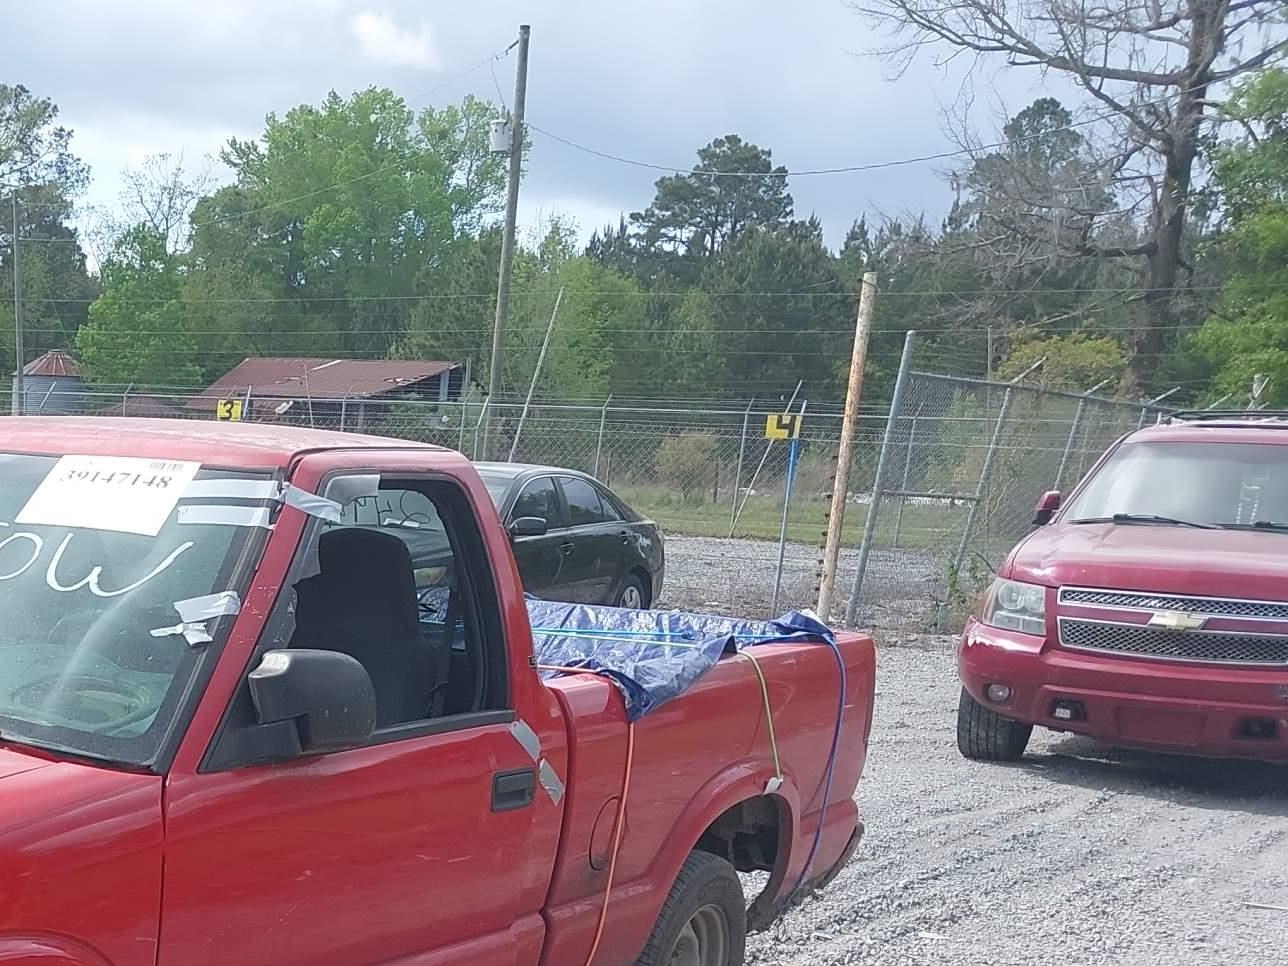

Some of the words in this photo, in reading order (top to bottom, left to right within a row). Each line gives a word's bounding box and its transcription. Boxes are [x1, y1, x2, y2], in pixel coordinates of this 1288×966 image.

[219, 401, 234, 420] 3
[776, 414, 798, 439] 4
[60, 469, 173, 489] 39147148
